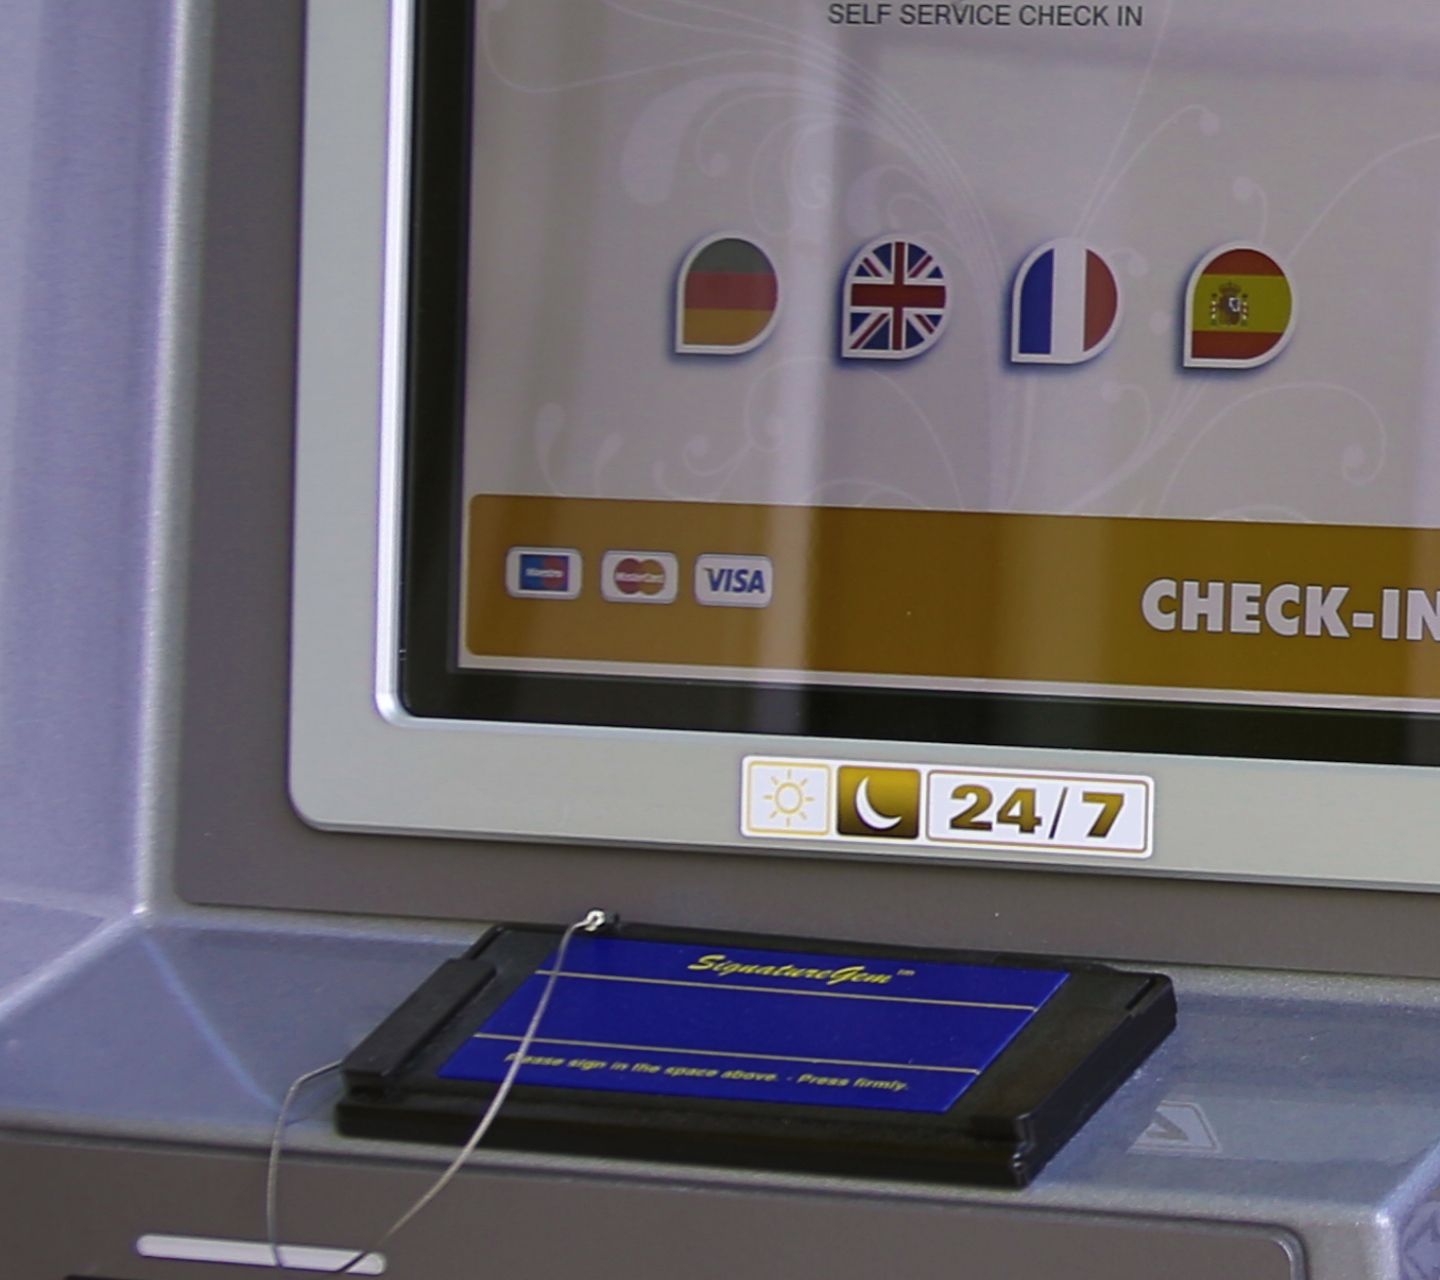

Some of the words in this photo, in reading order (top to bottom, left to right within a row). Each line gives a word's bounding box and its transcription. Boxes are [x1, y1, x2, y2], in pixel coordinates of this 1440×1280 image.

[828, 3, 892, 25] SELF
[899, 3, 1011, 26] SERVICE
[1019, 5, 1109, 27] CHECK
[1117, 6, 1143, 27] IN
[703, 567, 766, 594] VISA
[948, 783, 1126, 840] 24/7
[566, 1059, 607, 1071] sign
[610, 1061, 629, 1071] in
[631, 1063, 661, 1074] the
[664, 1066, 719, 1077] space
[796, 1073, 850, 1087] Press
